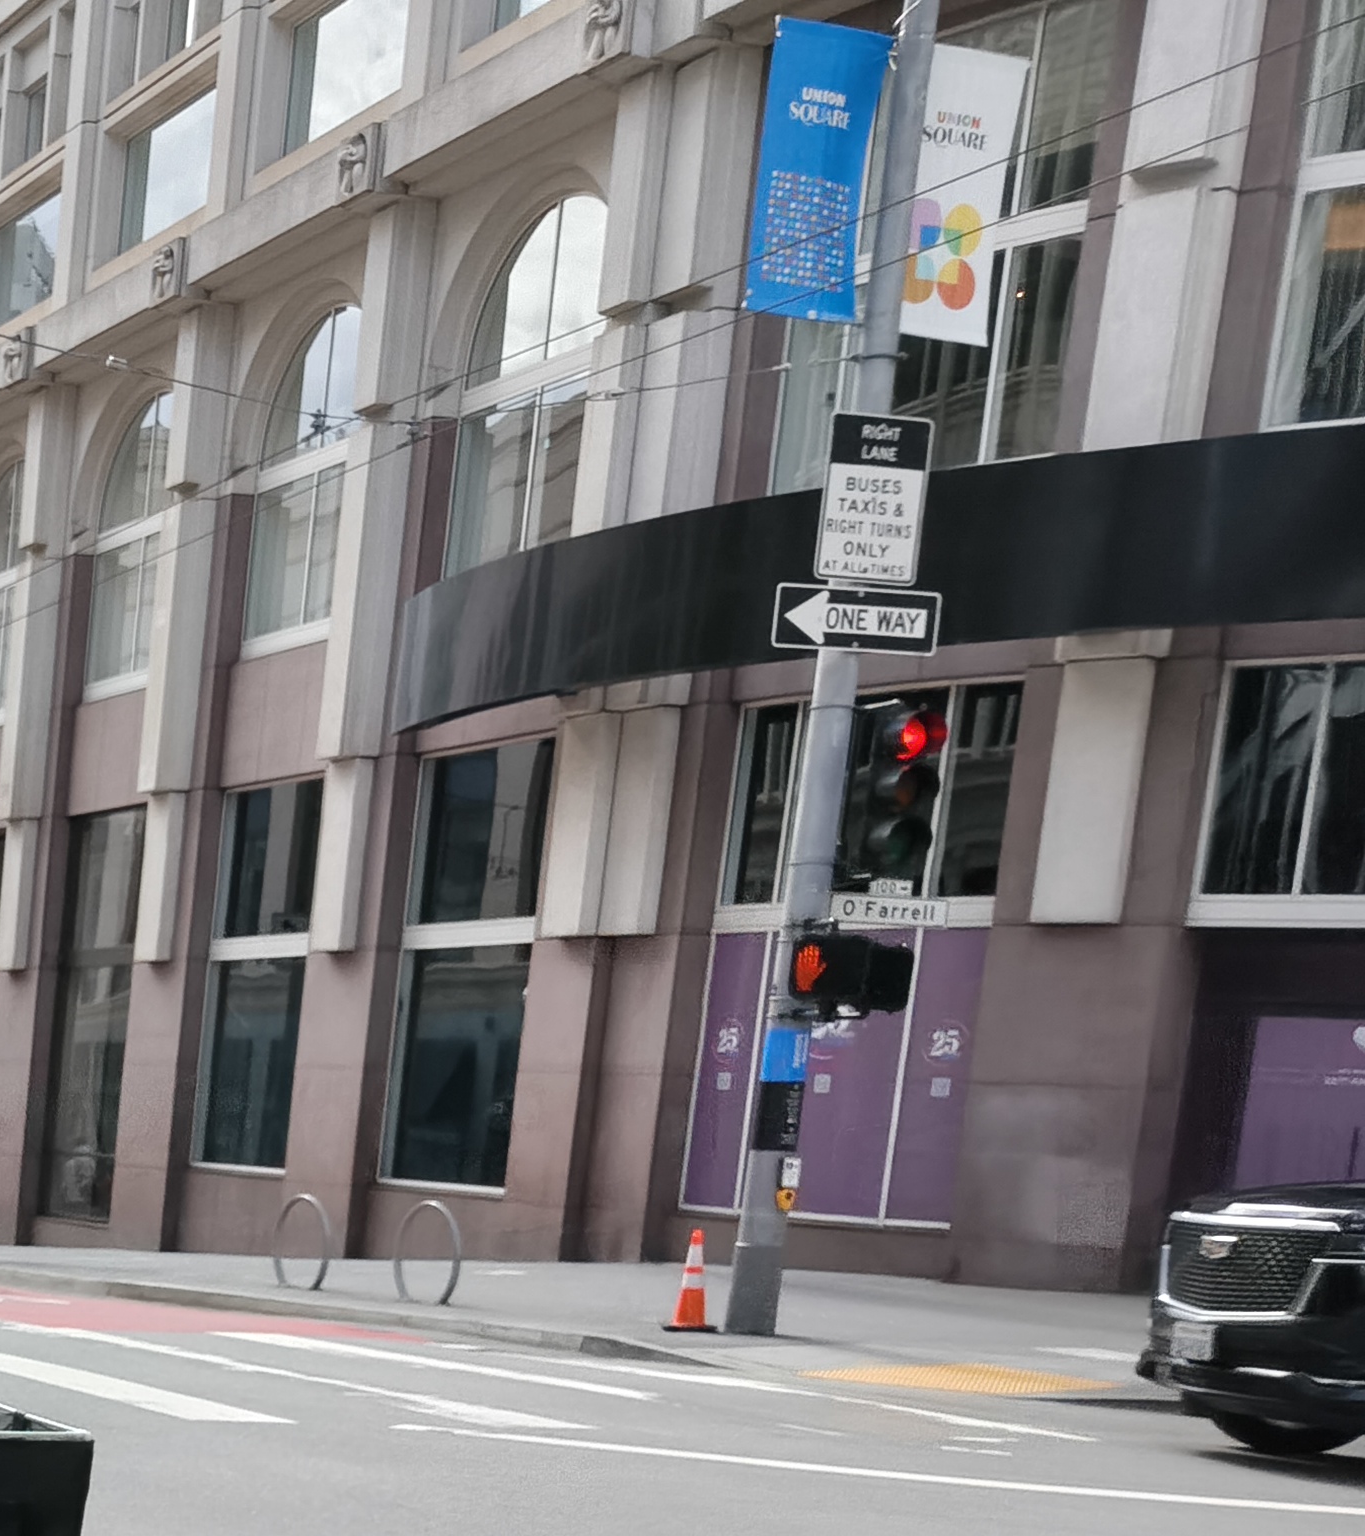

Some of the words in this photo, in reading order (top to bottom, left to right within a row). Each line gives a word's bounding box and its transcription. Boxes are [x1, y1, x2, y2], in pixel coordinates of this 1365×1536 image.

[802, 87, 847, 108] UNION
[789, 101, 851, 130] SQUARE
[937, 111, 982, 129] UNION
[921, 124, 988, 151] SQUARE
[861, 423, 902, 442] RIGHT
[860, 445, 900, 462] LANE
[845, 476, 903, 495] BUSES
[837, 498, 888, 516] TAXIS
[893, 503, 905, 517] &
[825, 518, 864, 534] RIGHT
[869, 522, 912, 539] TURNS
[842, 540, 891, 559] ONLY
[821, 559, 838, 571] AT
[869, 564, 906, 577] TIMES
[825, 607, 869, 631] ONE
[876, 609, 921, 633] WAY
[875, 880, 898, 894] 100
[842, 899, 936, 922] O'Farrell
[930, 1029, 961, 1057] 25
